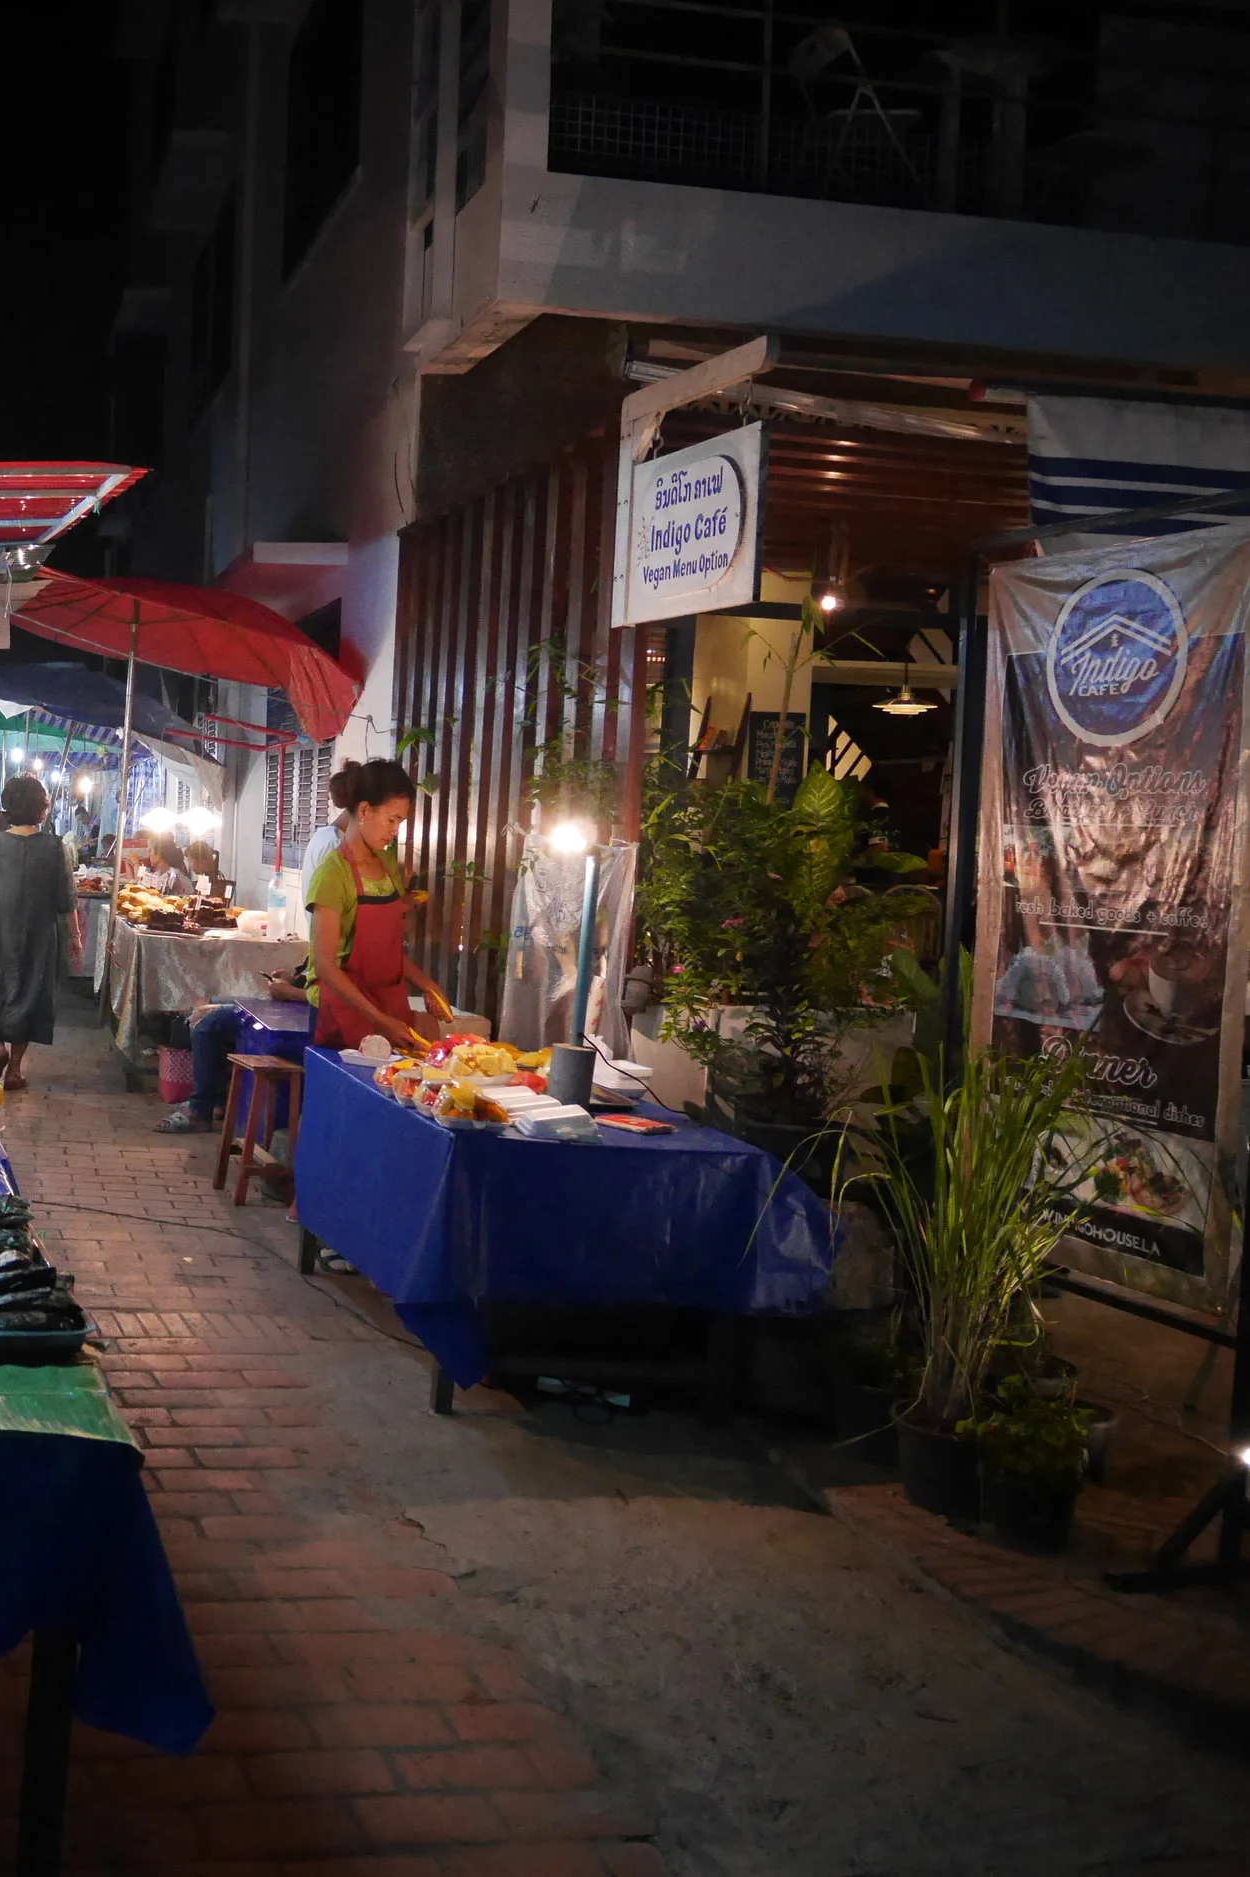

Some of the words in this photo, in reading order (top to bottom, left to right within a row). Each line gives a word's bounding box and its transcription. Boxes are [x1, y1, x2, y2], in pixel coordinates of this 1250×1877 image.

[650, 519, 691, 555] Indigo
[694, 506, 729, 541] Café
[643, 564, 671, 591] Vegan
[672, 557, 698, 579] Menu
[699, 550, 729, 580] Option
[1069, 645, 1160, 697] Indigo
[1078, 683, 1121, 697] CAFE
[1049, 896, 1094, 920] baked
[1095, 906, 1142, 926] goods
[1038, 1035, 1159, 1089] Dnner
[1163, 1101, 1205, 1129] dishes
